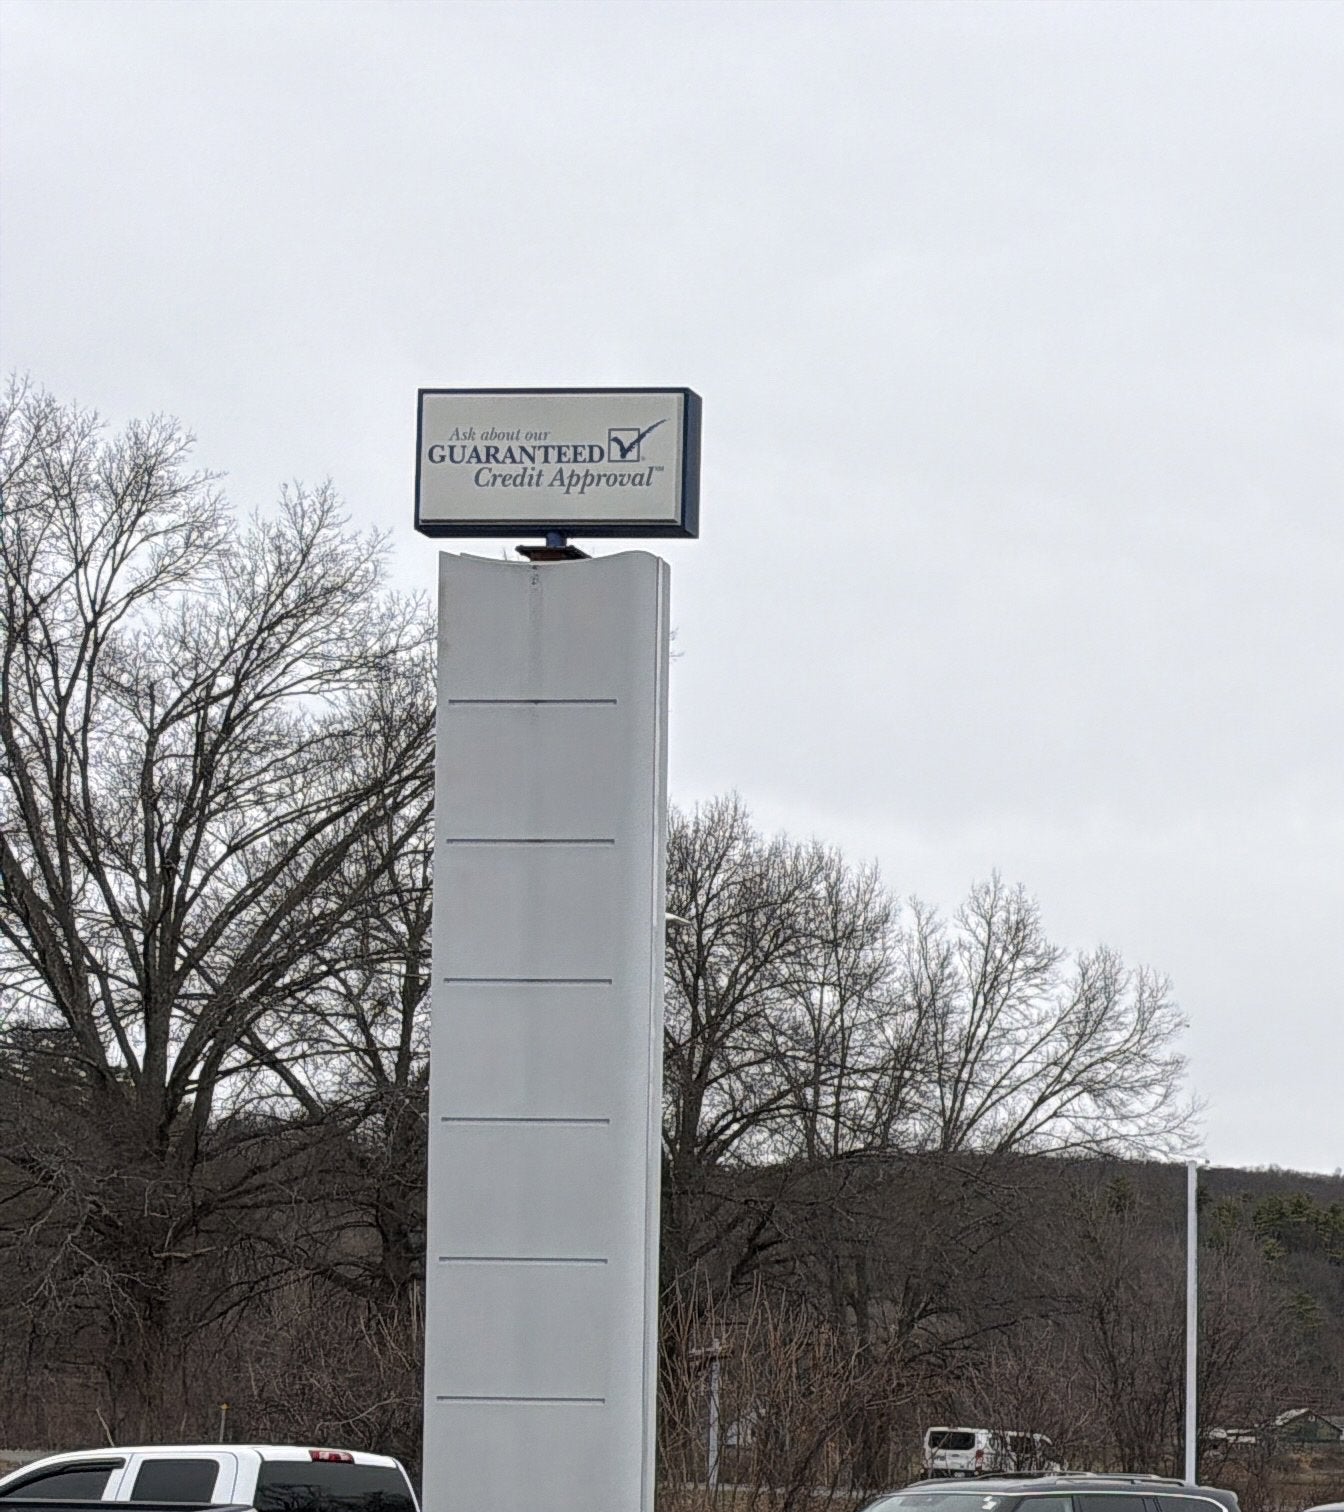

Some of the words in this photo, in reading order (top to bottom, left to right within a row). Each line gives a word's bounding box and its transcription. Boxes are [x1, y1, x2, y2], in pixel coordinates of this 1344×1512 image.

[449, 427, 476, 441] Ask
[480, 427, 521, 441] about
[524, 430, 551, 441] our
[428, 444, 605, 464] GUARANTEED
[474, 466, 544, 487] Credit
